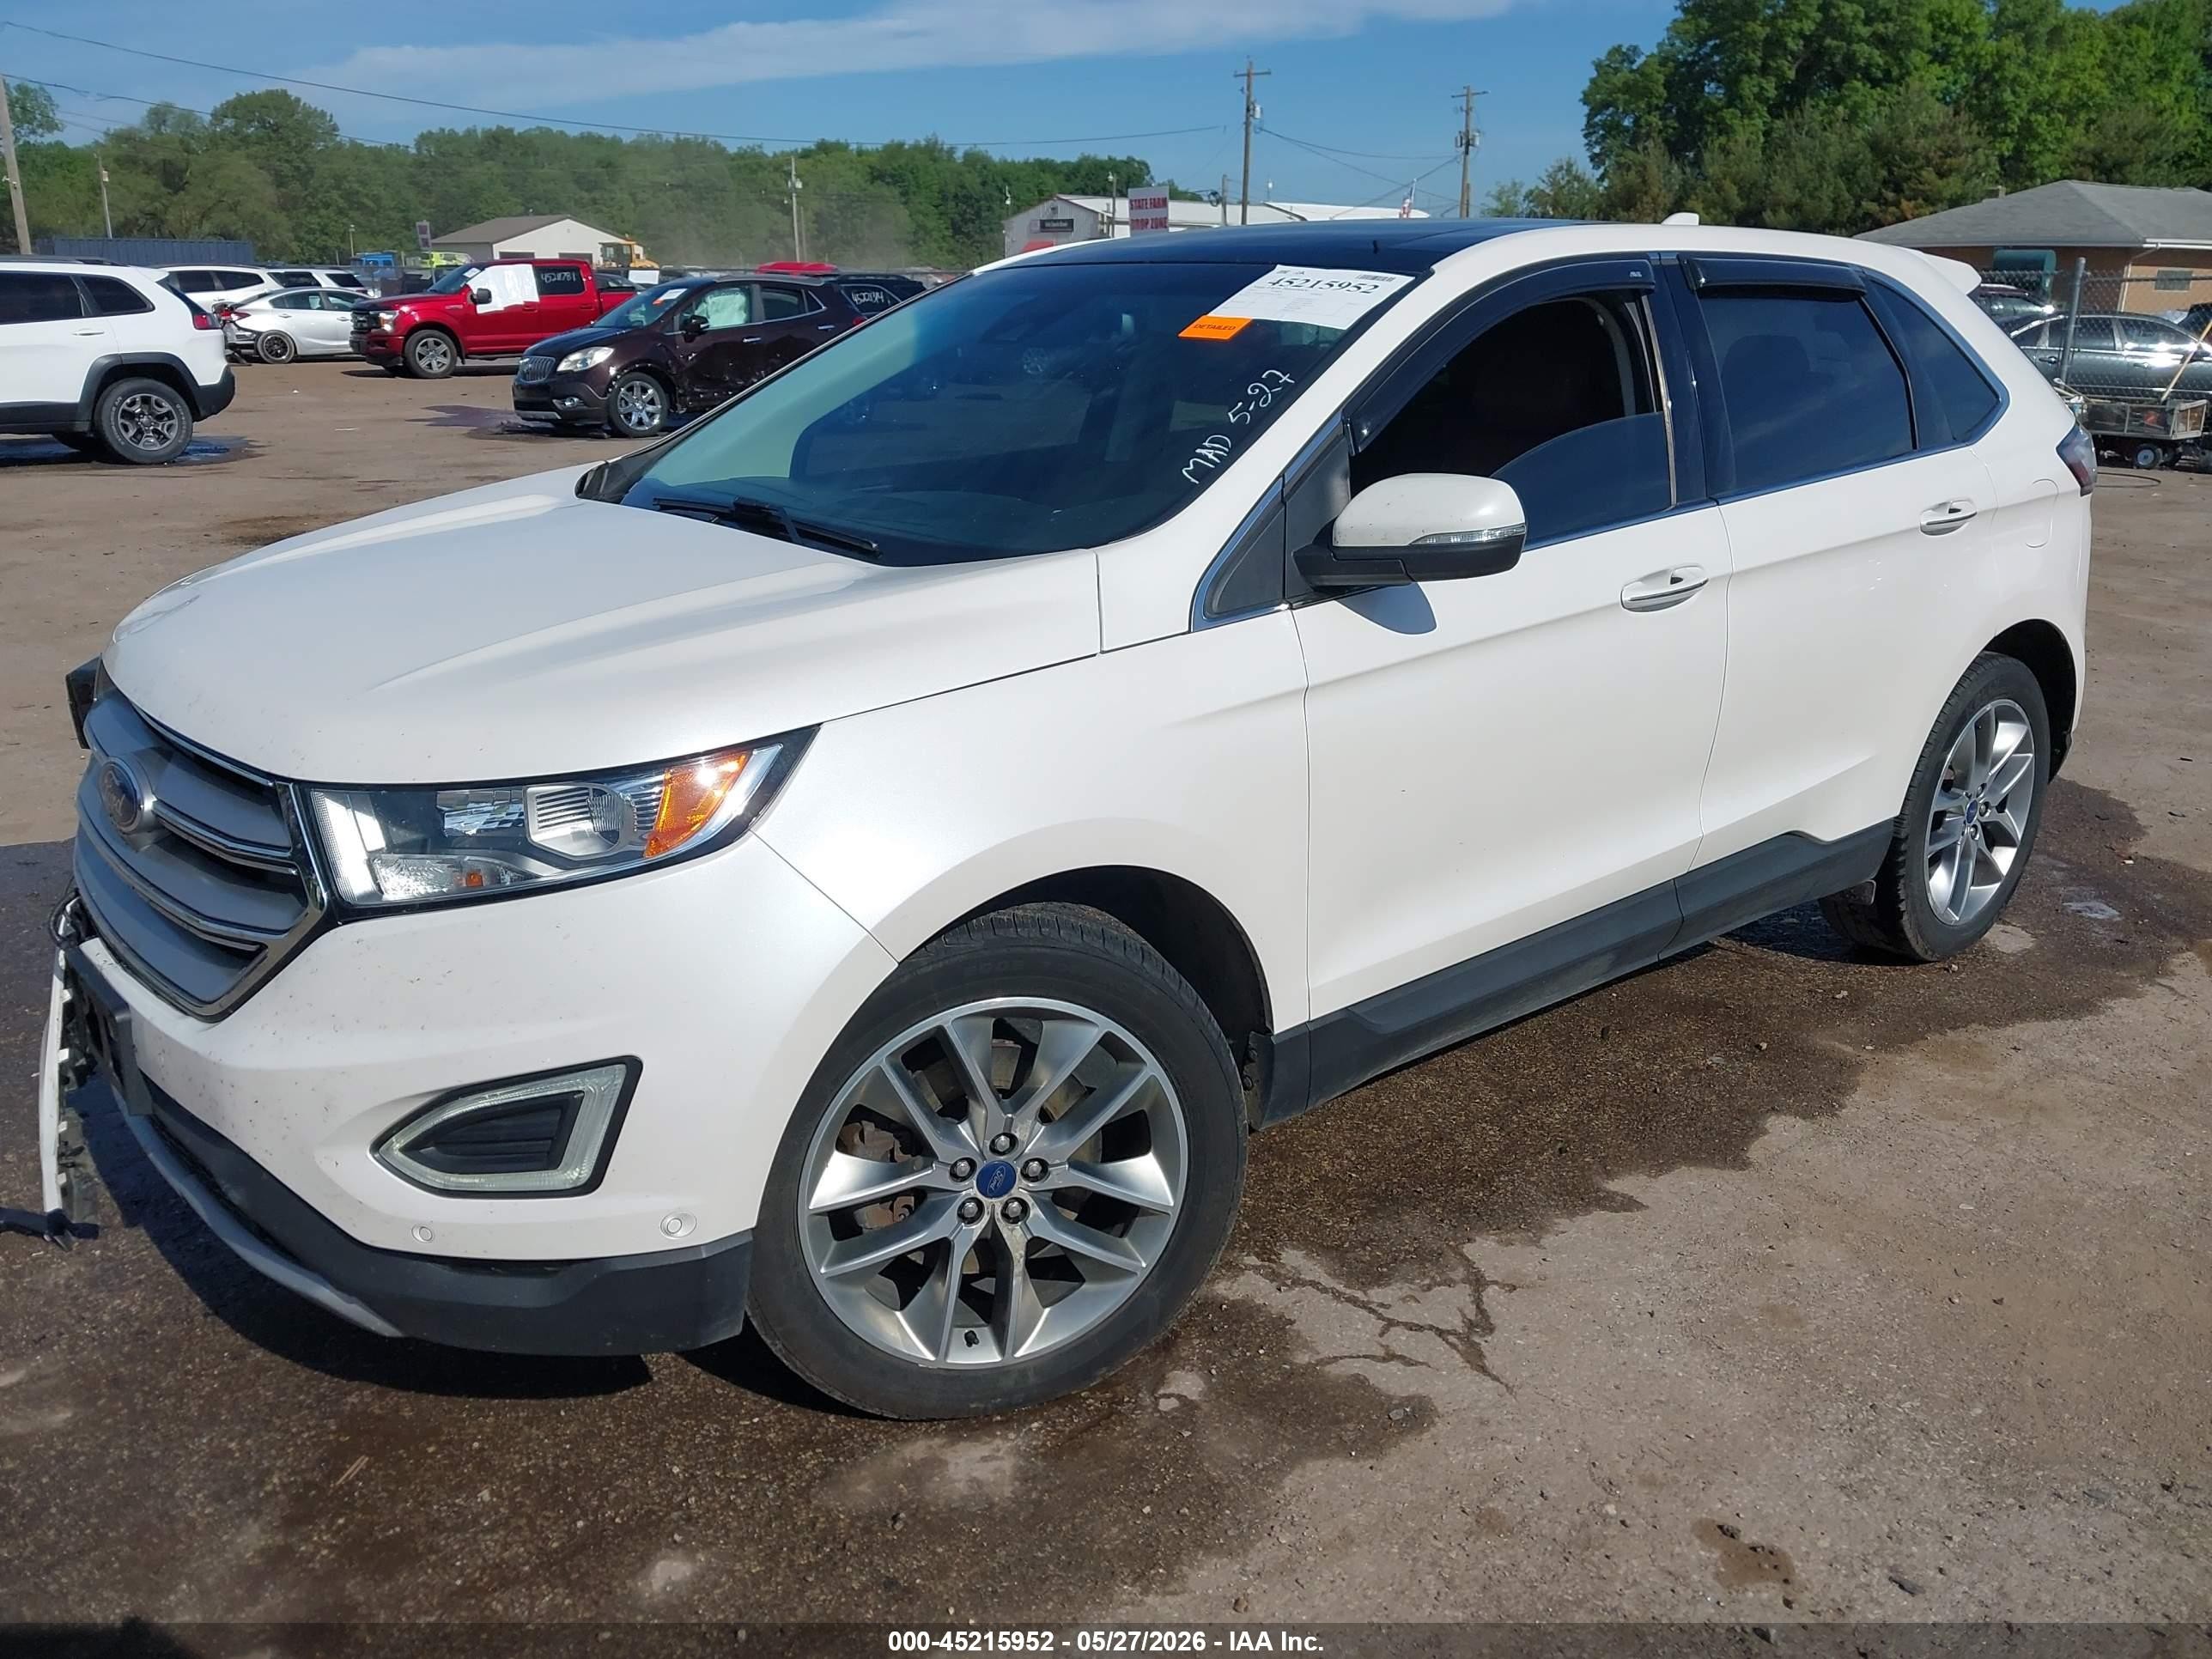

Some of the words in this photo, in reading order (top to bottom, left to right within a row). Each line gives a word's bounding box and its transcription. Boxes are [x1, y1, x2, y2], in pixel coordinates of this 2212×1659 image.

[1129, 198, 1148, 210] STATE
[1267, 276, 1380, 295] 45215952
[1182, 434, 1231, 484] MAD
[1228, 369, 1295, 424] 5-27
